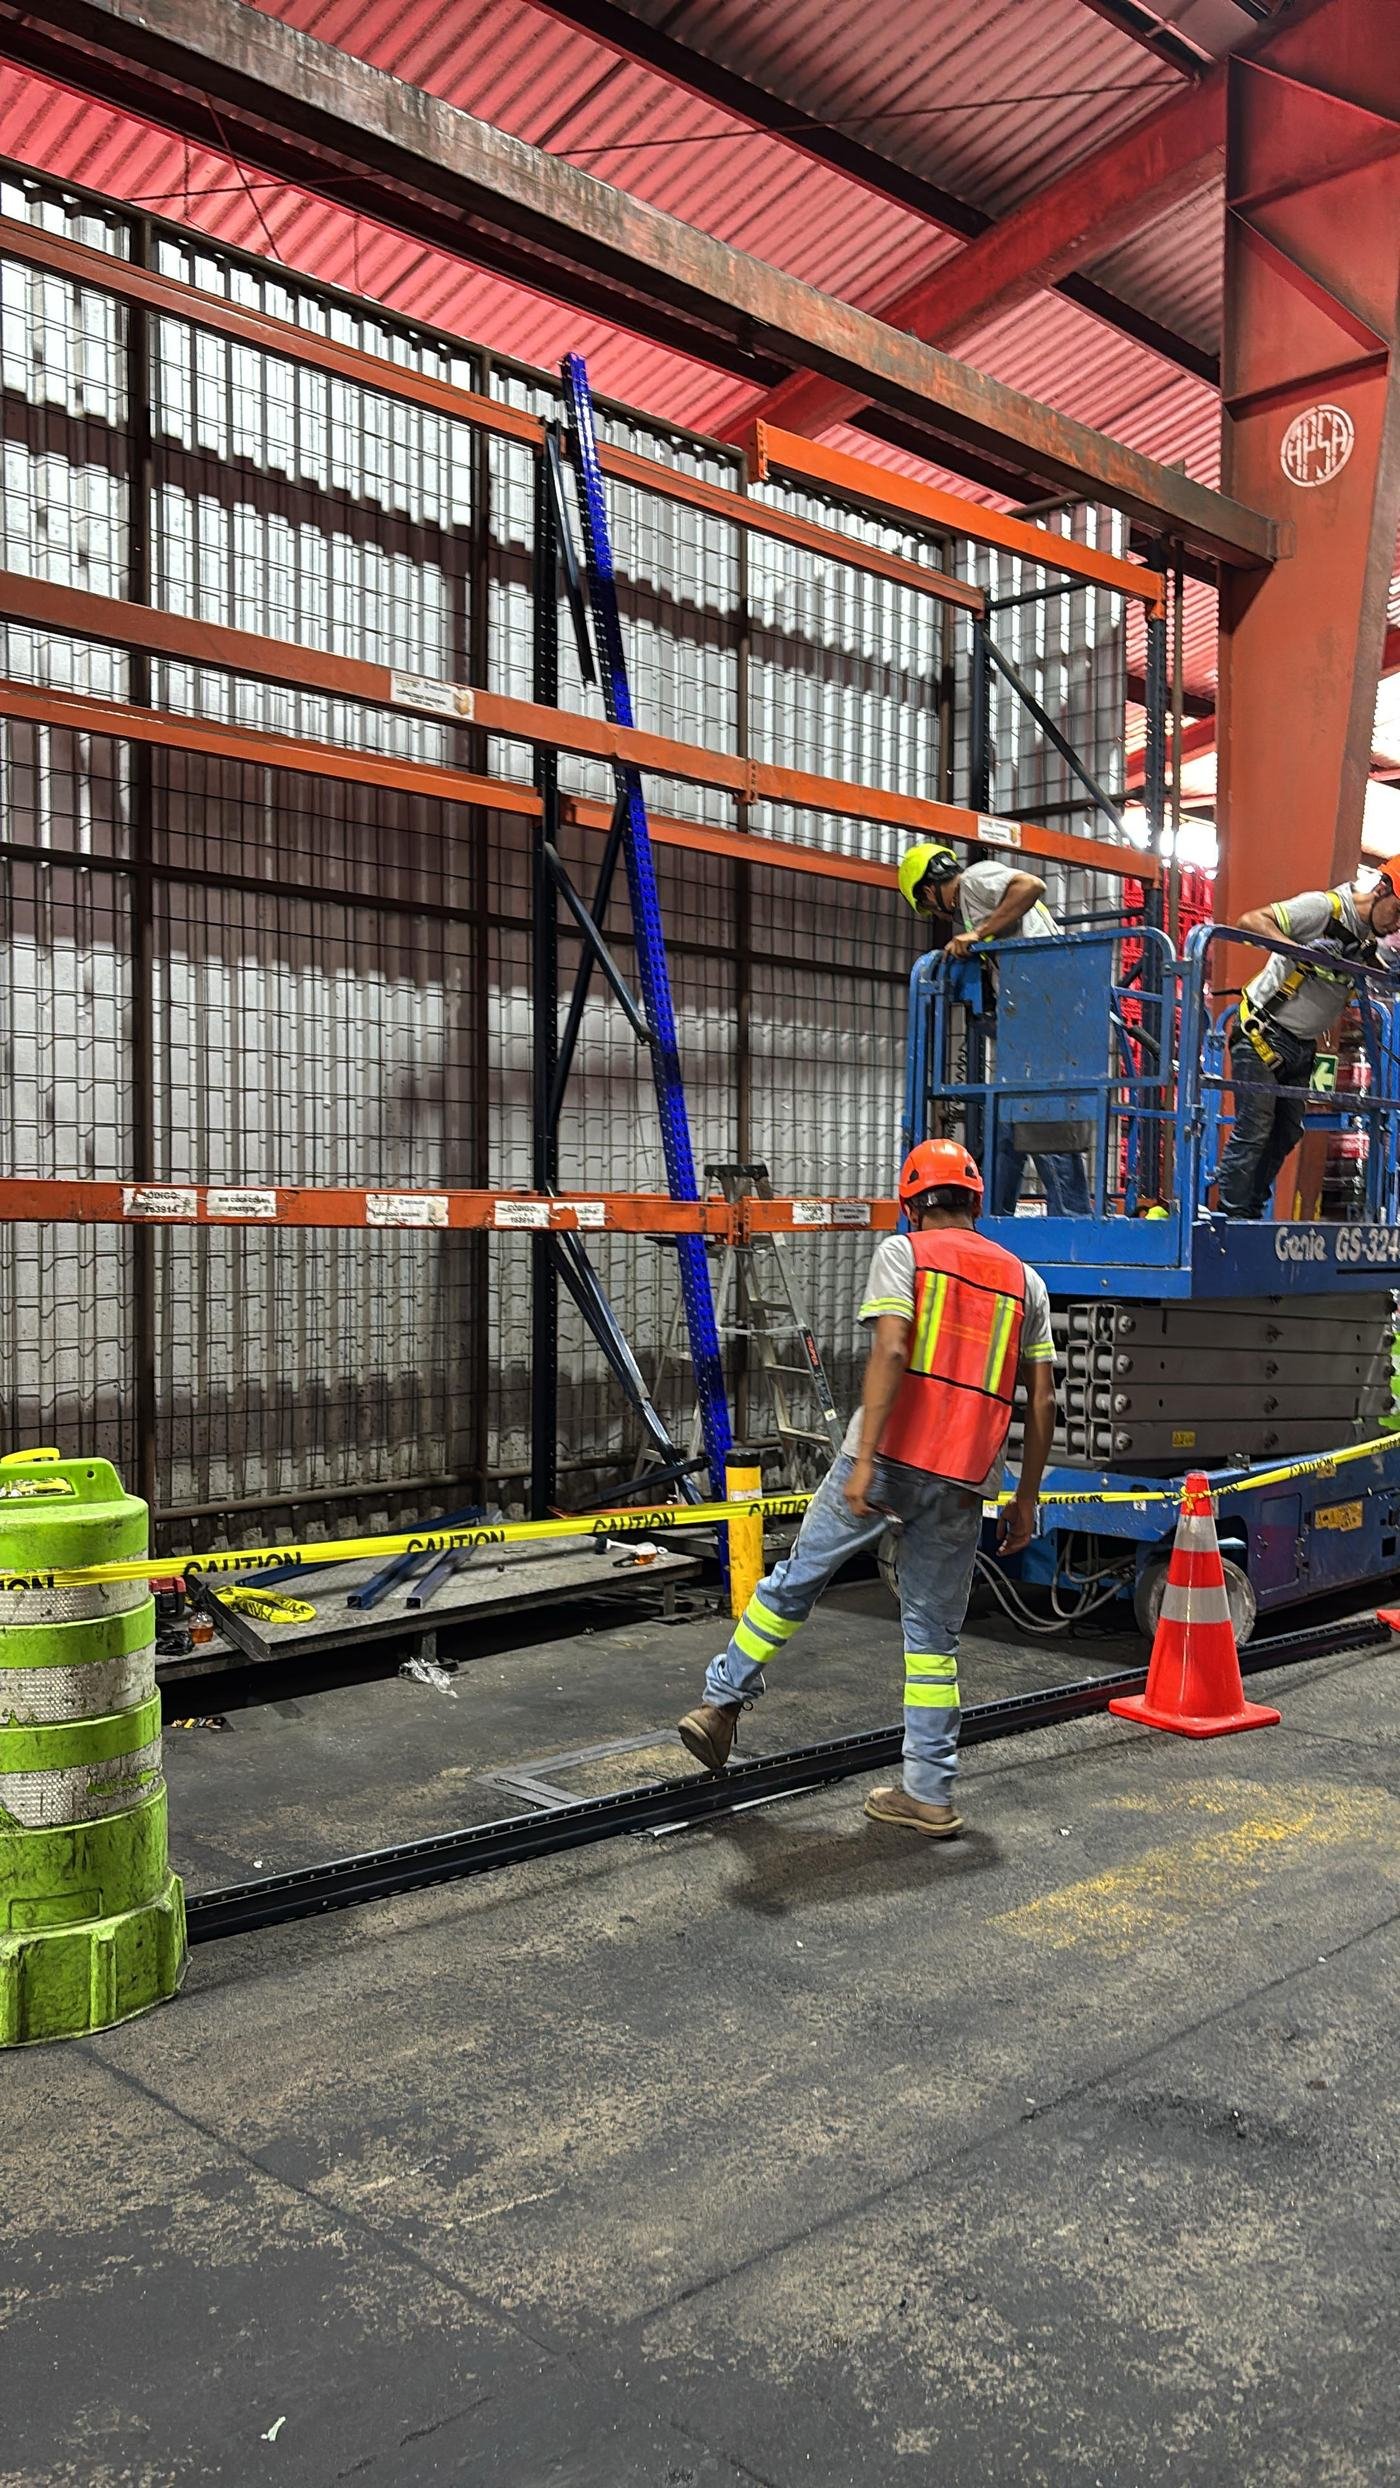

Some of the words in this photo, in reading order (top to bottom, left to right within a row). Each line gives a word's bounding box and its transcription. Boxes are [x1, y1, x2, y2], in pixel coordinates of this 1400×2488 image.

[1275, 1226, 1328, 1262] Genie
[1335, 1226, 1400, 1263] GS-324
[748, 1498, 812, 1517] CAUTIO
[593, 1511, 676, 1533] CAUTION
[407, 1530, 505, 1554] CAUTION
[184, 1551, 301, 1576] CAUTION
